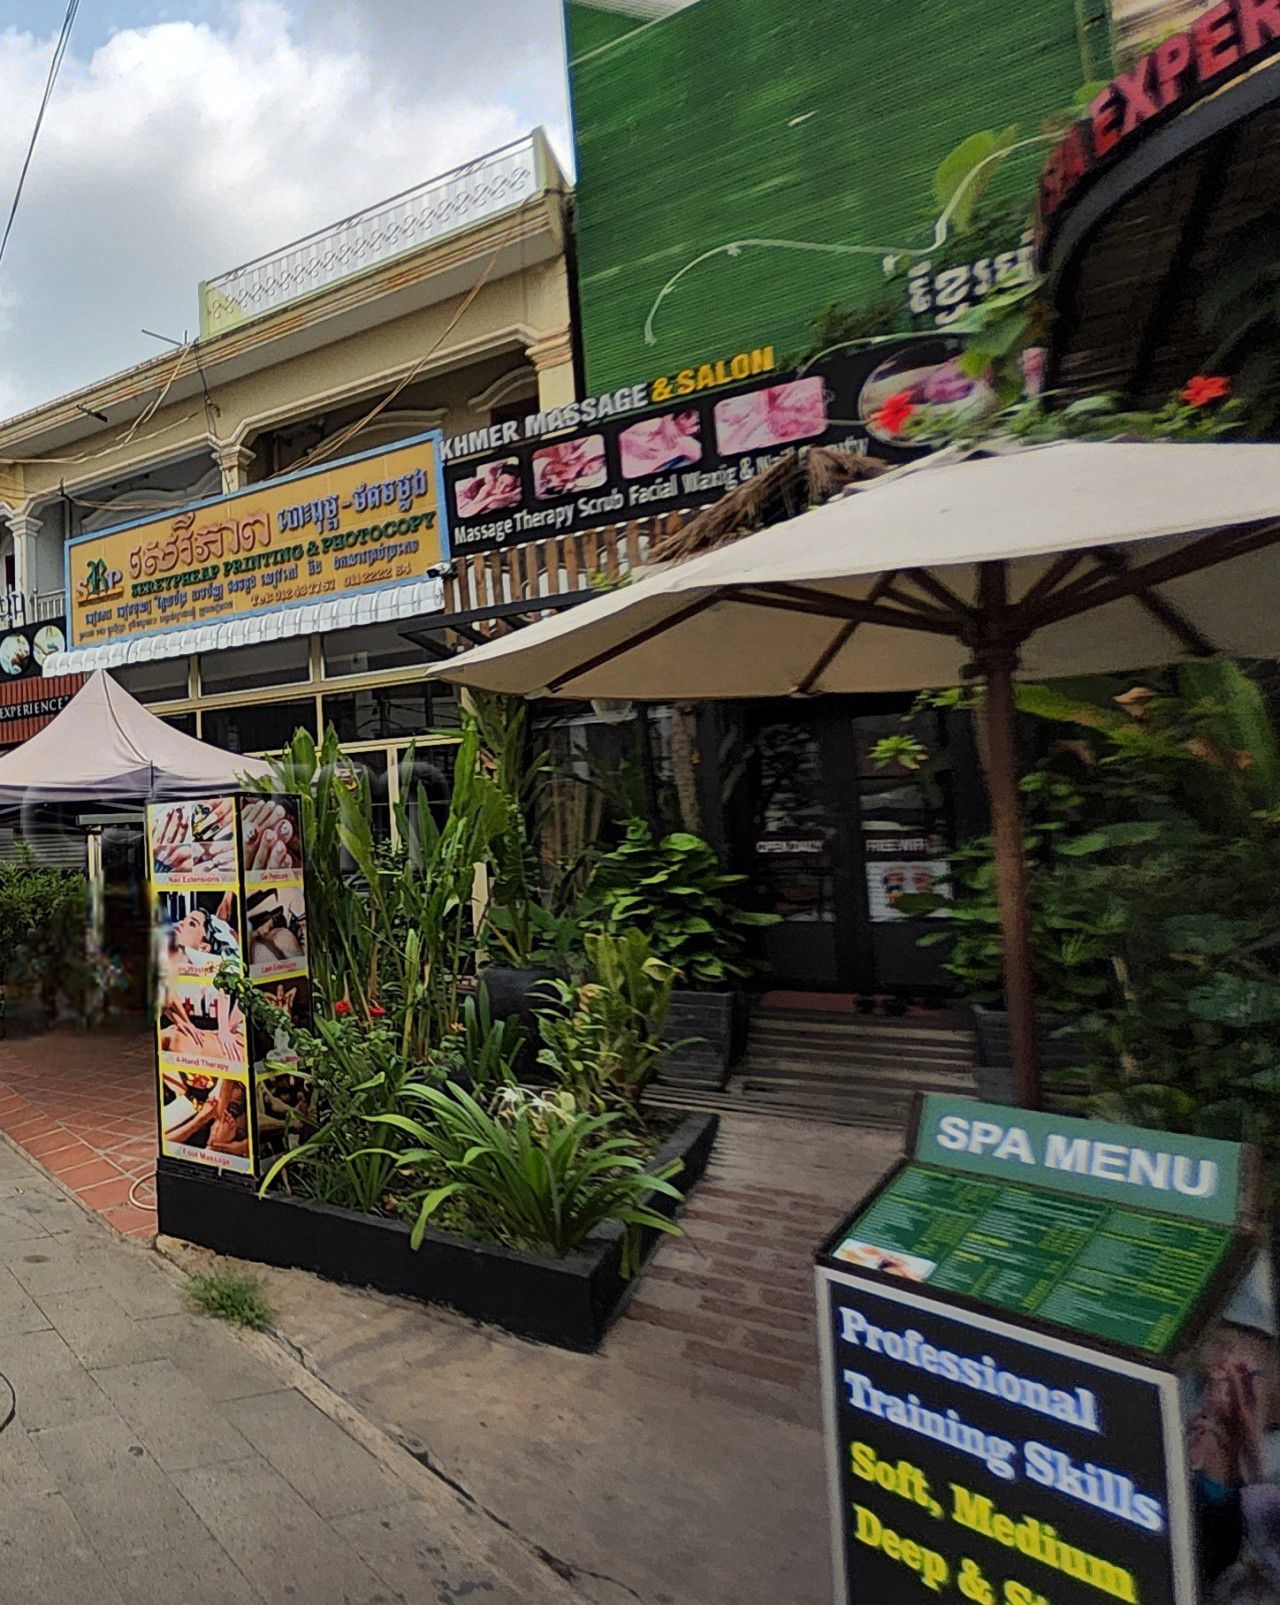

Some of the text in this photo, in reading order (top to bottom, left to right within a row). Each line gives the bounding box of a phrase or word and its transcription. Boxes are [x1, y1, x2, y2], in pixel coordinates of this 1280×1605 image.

[439, 345, 775, 462] KHMER MASSAGE & SALON
[222, 543, 304, 578] PRINTING
[305, 540, 320, 557] &
[320, 510, 437, 555] PHOTOCOPY
[454, 516, 513, 546] Massage
[513, 502, 576, 533] Therapy
[577, 485, 625, 518] Scrub
[628, 473, 679, 507] Facial
[739, 456, 755, 480] &
[935, 1115, 1219, 1199] SPA MENU
[838, 1306, 1102, 1433] Professional
[843, 1368, 1166, 1532] Training Skills
[850, 1441, 1138, 1604] Soft, Medium
[853, 1502, 950, 1592] Deep
[958, 1557, 997, 1605] &
